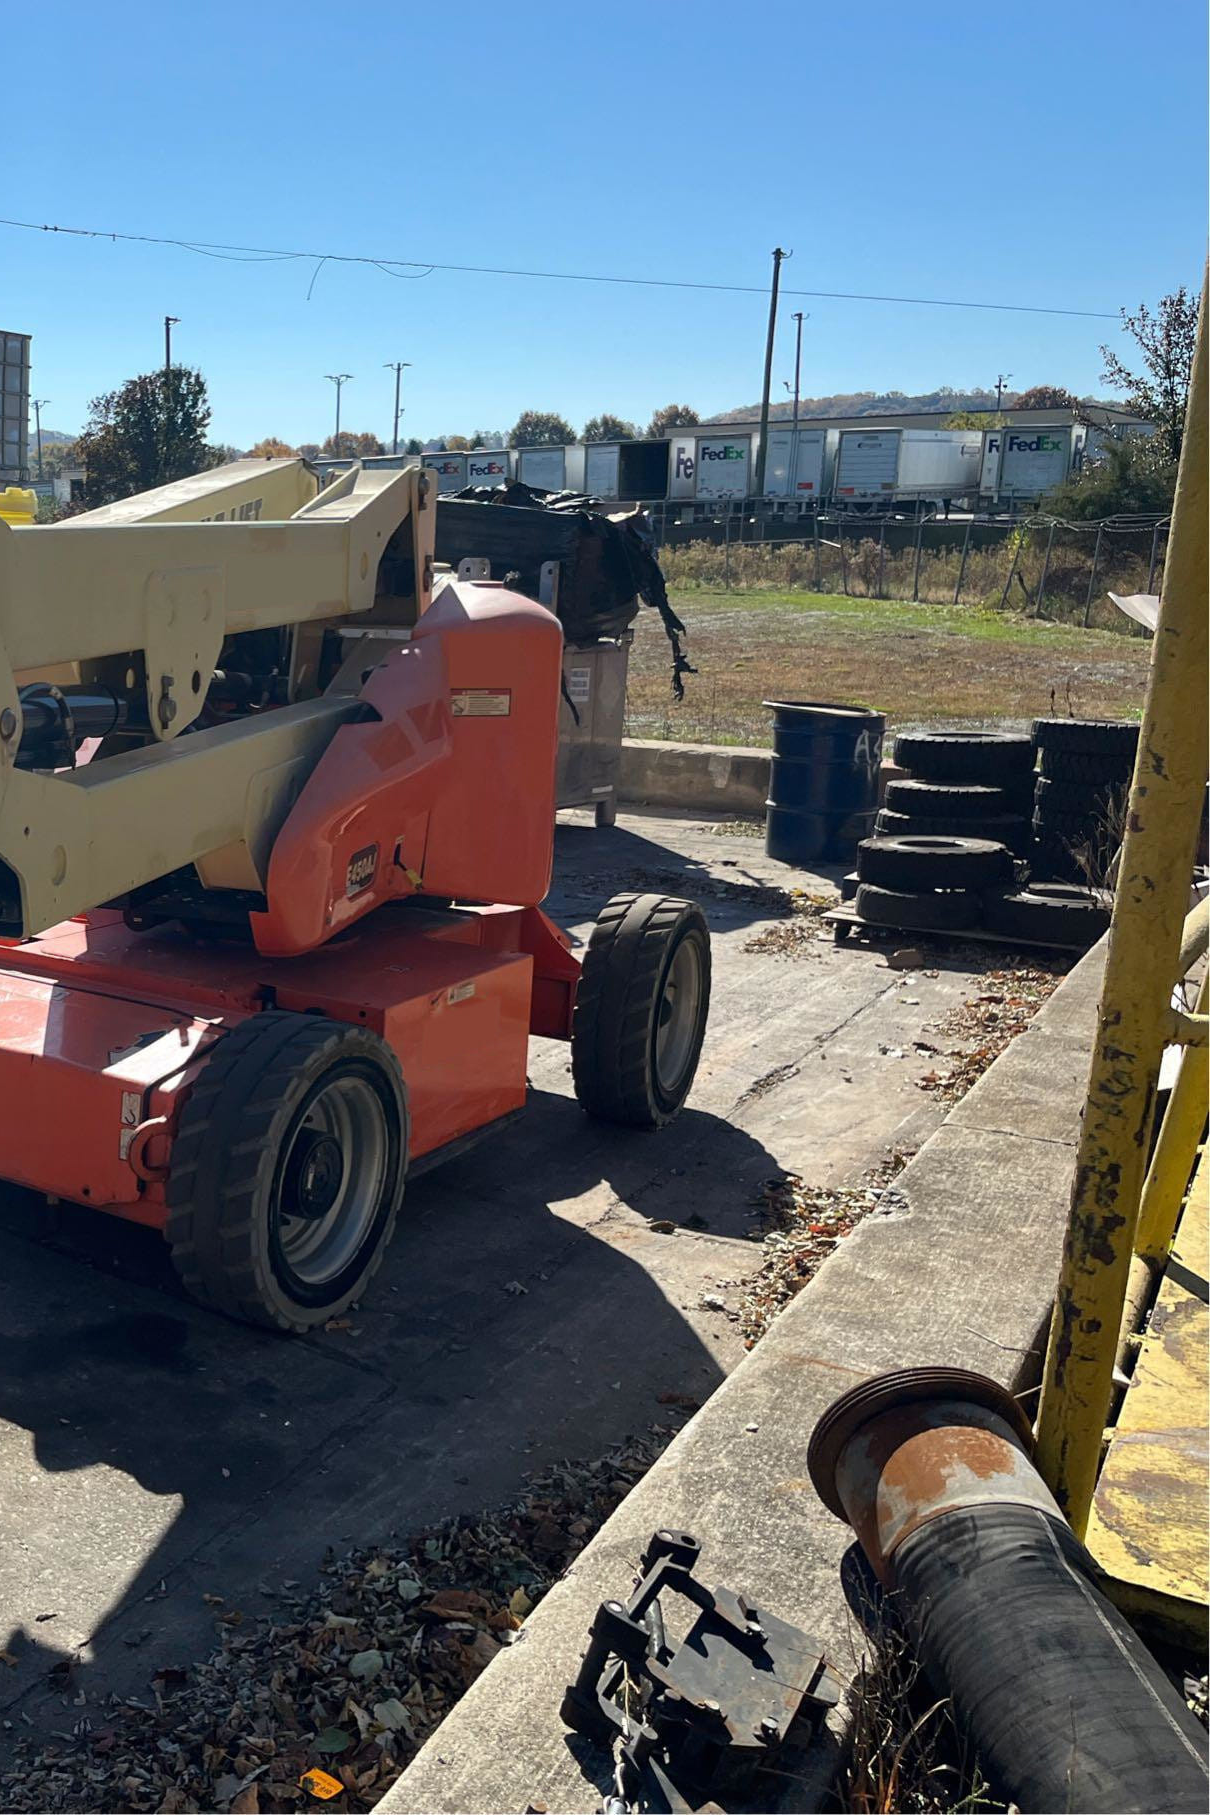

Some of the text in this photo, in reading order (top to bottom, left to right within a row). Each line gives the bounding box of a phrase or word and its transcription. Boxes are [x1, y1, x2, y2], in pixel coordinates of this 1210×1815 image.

[1009, 436, 1062, 451] FedEx
[701, 446, 743, 460] FedEx
[470, 462, 504, 476] FedEx
